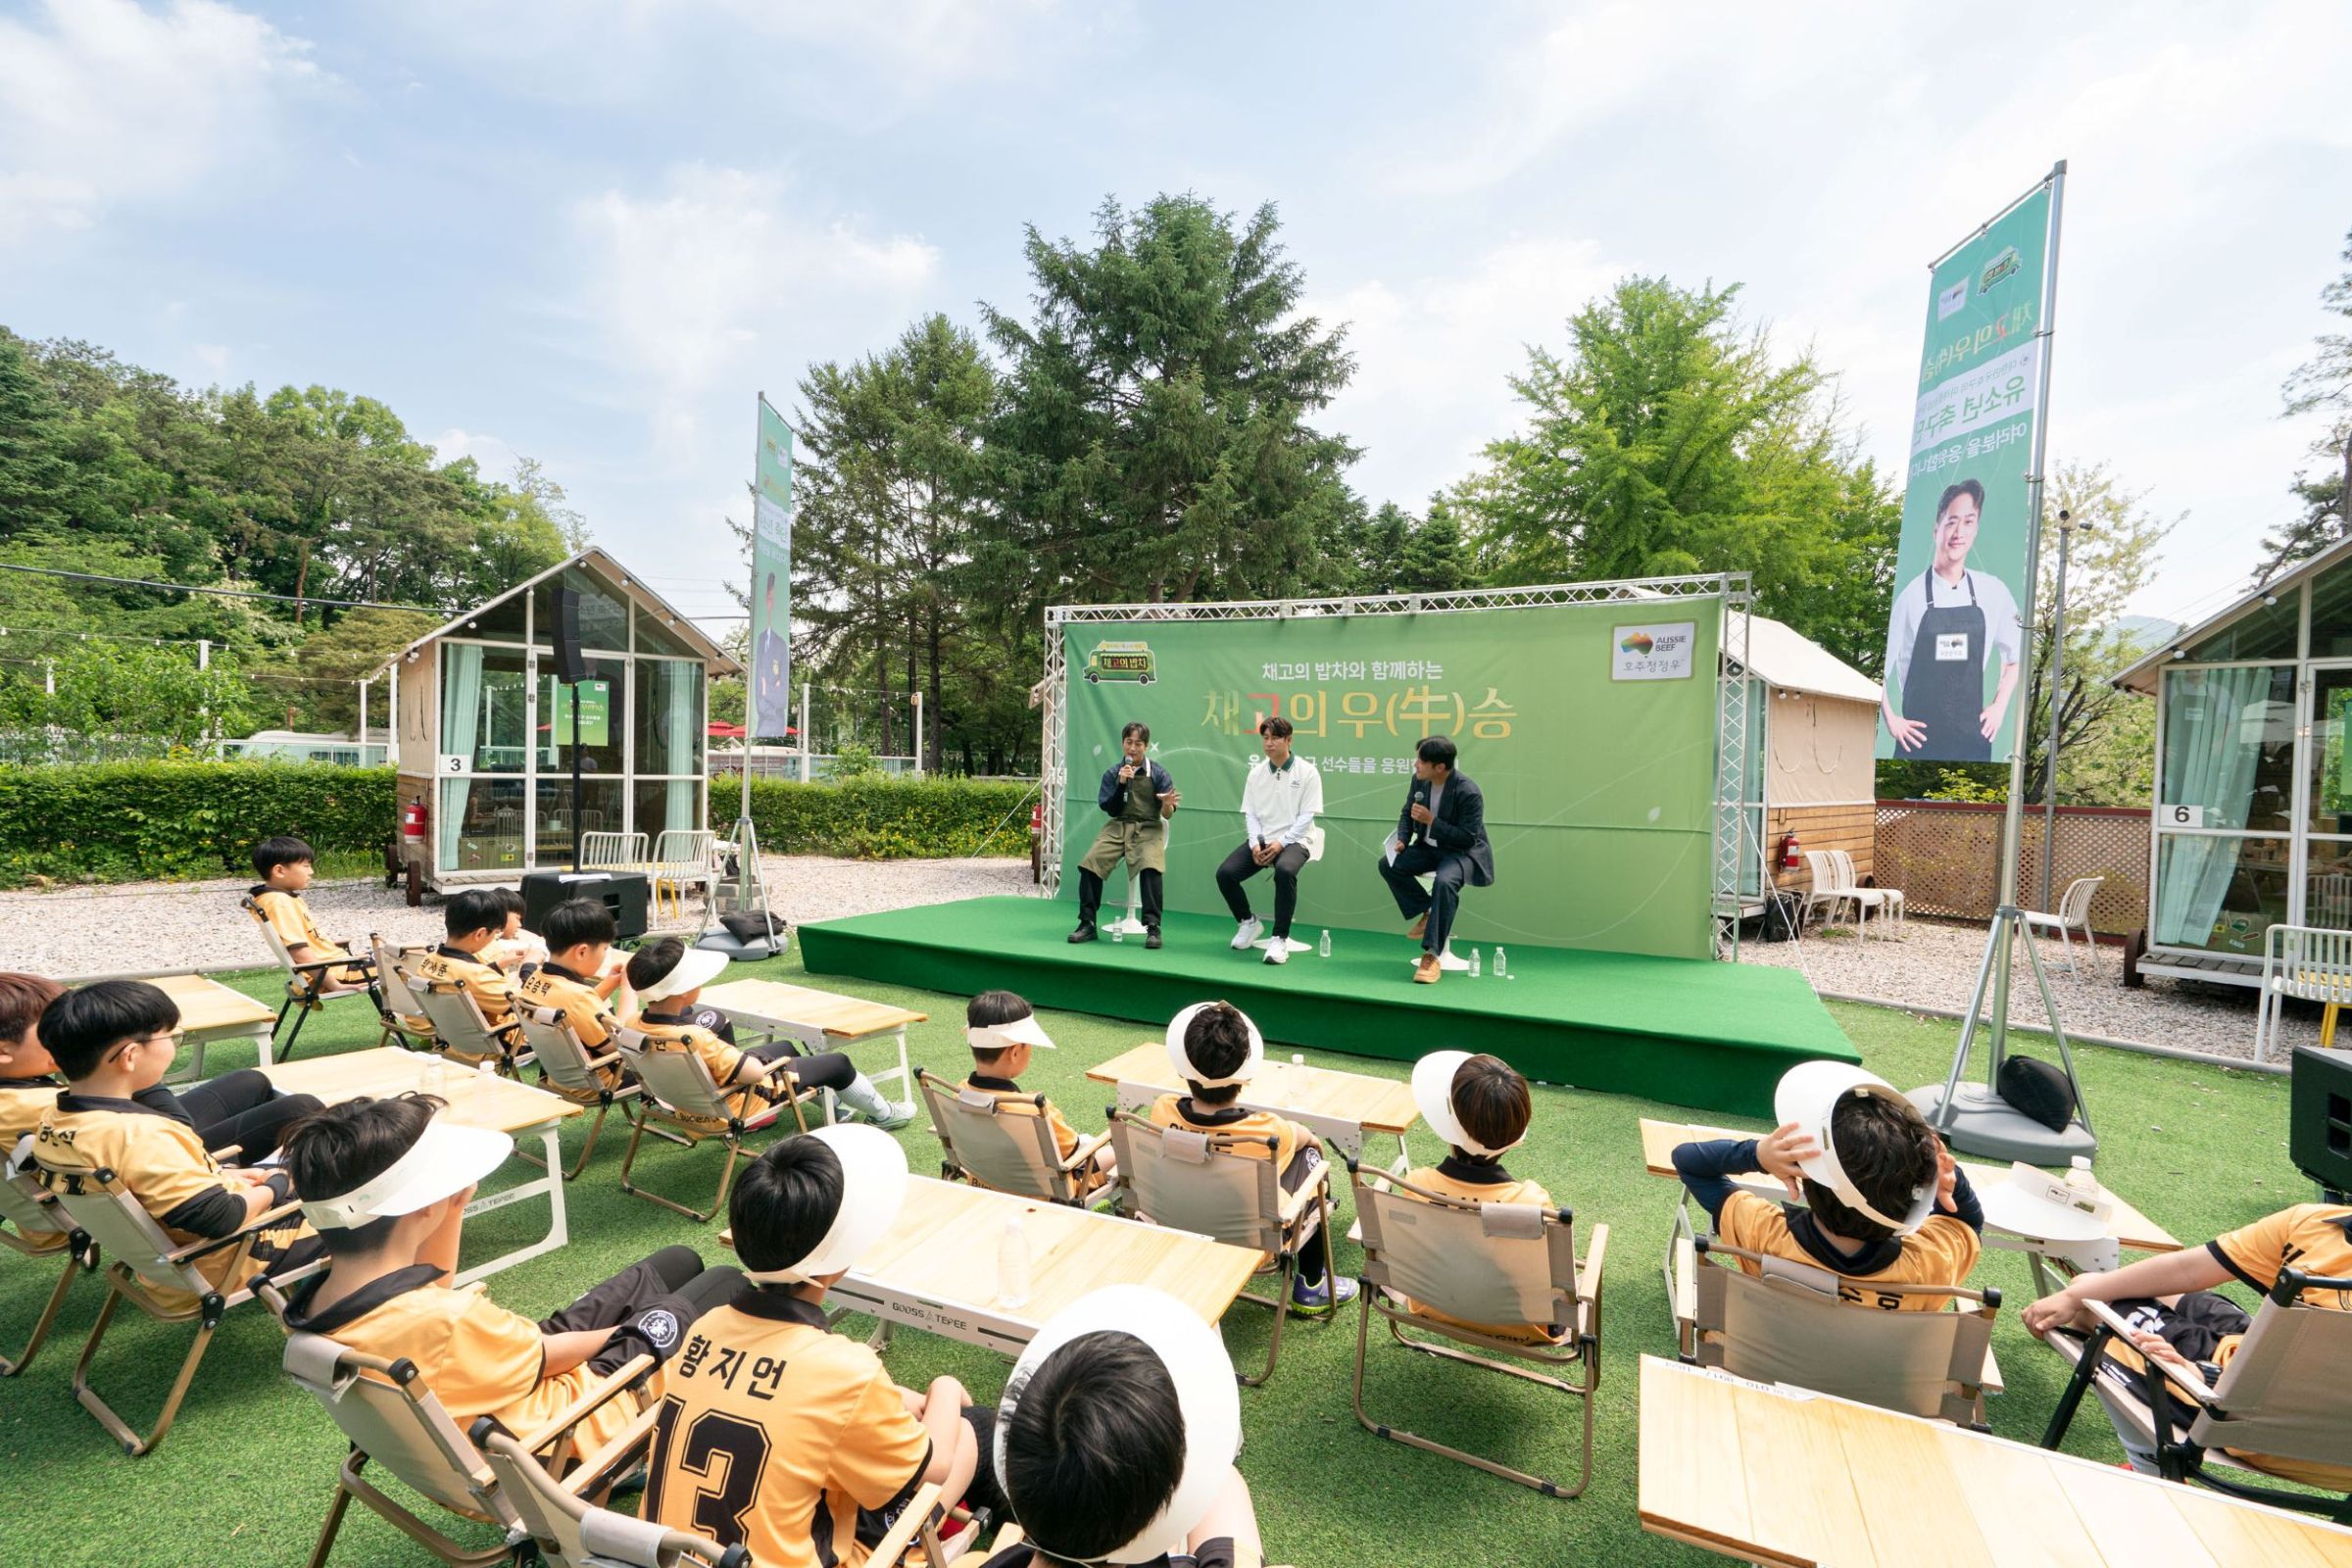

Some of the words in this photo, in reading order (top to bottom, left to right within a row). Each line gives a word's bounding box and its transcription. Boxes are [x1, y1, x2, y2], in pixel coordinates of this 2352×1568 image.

[1655, 643, 1677, 652] BEEF
[1656, 635, 1687, 644] AUSSIE
[1262, 662, 1310, 681] 채고의
[1315, 661, 1365, 681] 밥차와
[1371, 660, 1444, 681] 함께하는
[1622, 660, 1681, 673] 호주청정우
[1200, 689, 1327, 738] 채고의
[451, 758, 462, 772] 3
[1321, 756, 1377, 775] 선수들을
[2174, 806, 2190, 823] 6
[935, 1314, 967, 1330] TEPEE
[679, 1334, 787, 1400] 황지언
[645, 1393, 772, 1563] 13
